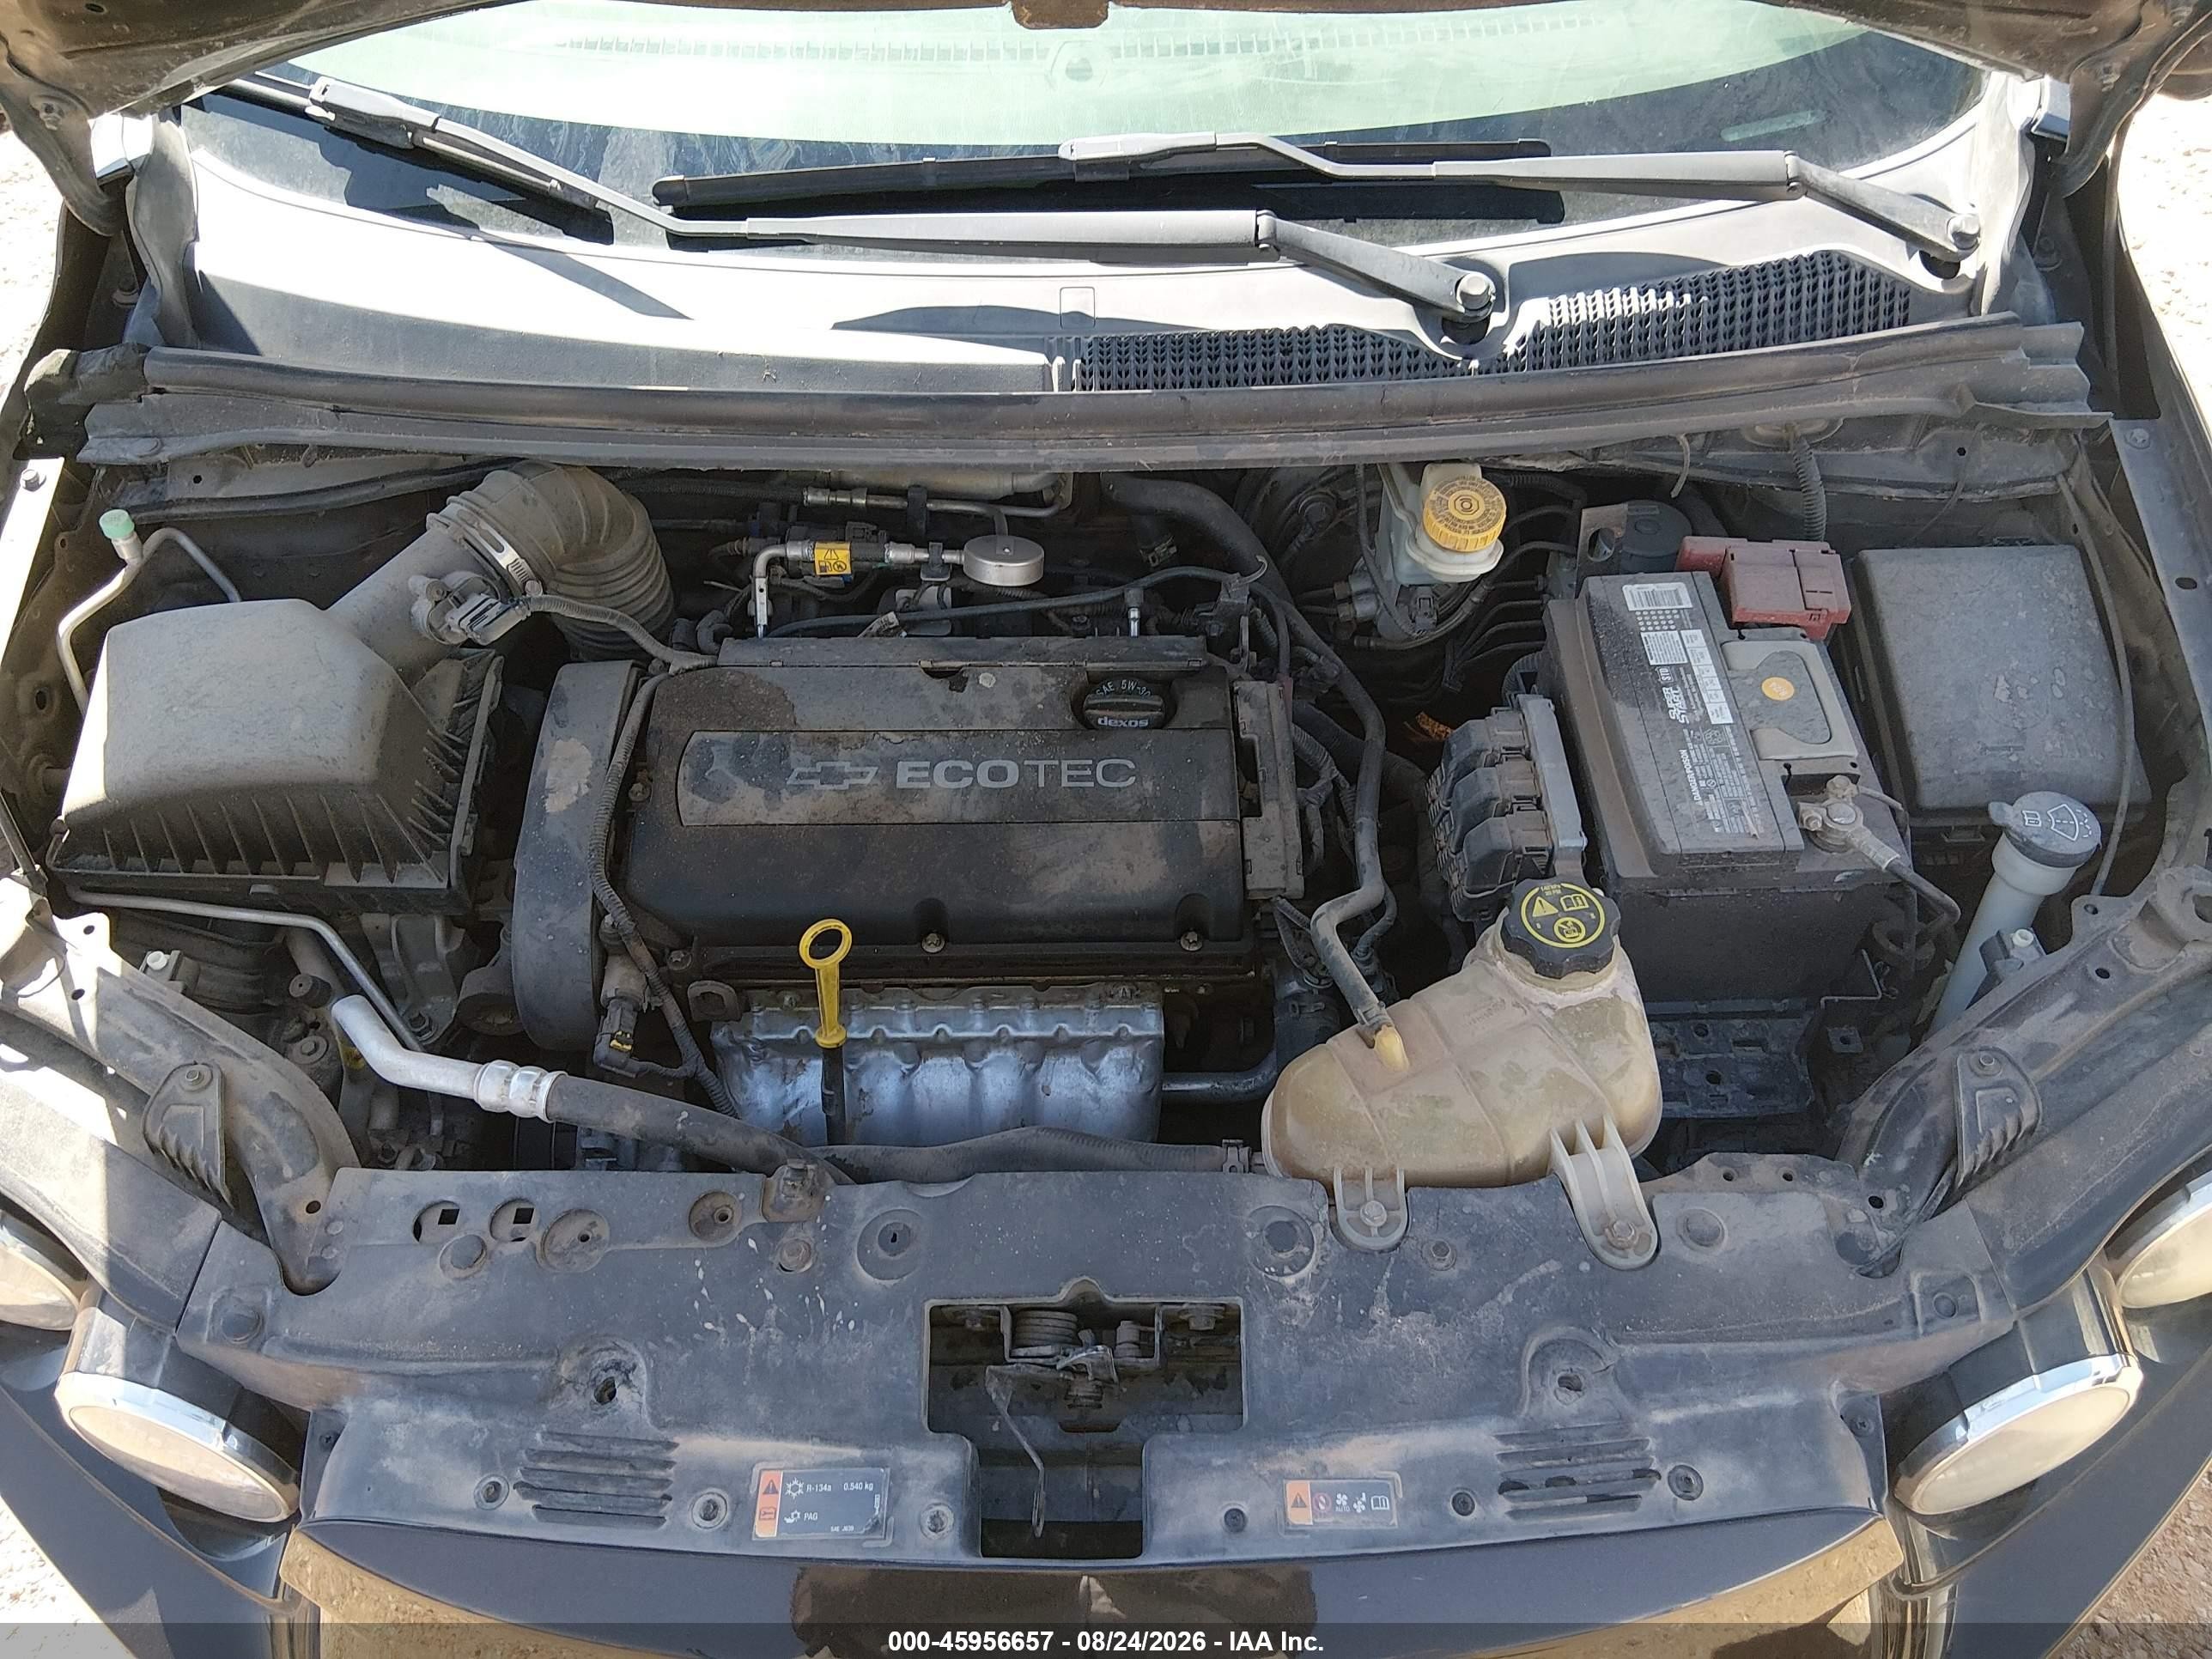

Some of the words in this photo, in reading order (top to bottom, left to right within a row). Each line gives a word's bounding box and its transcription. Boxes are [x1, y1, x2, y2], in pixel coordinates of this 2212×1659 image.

[1096, 681, 1115, 696] SAE
[1662, 687, 1676, 720] SUPER
[1097, 716, 1149, 728] dexos
[896, 758, 1136, 789] ECOTEC
[806, 1483, 831, 1492] R-134a
[843, 1482, 863, 1491] 0.540
[864, 1481, 873, 1492] kg
[804, 1512, 818, 1521] PAG
